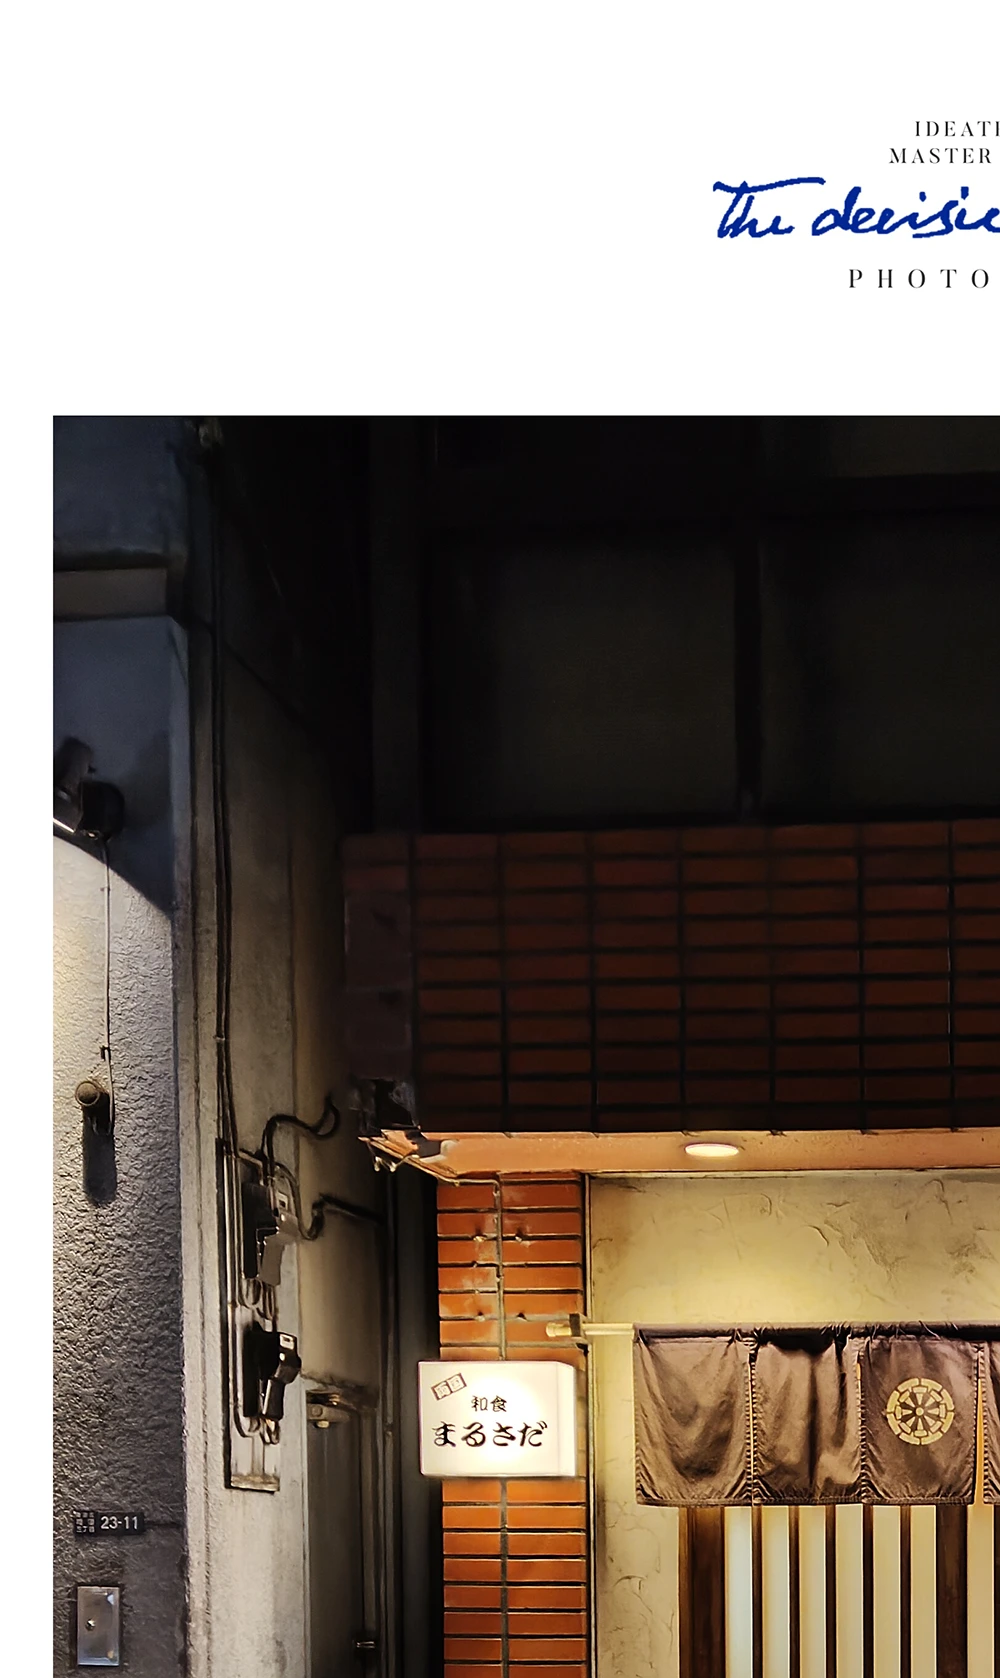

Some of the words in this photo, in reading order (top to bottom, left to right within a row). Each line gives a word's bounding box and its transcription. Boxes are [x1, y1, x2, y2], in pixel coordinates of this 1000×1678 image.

[471, 1395, 508, 1413] 和食
[432, 1420, 548, 1448] まるさだ
[100, 1516, 138, 1530] 23-11
